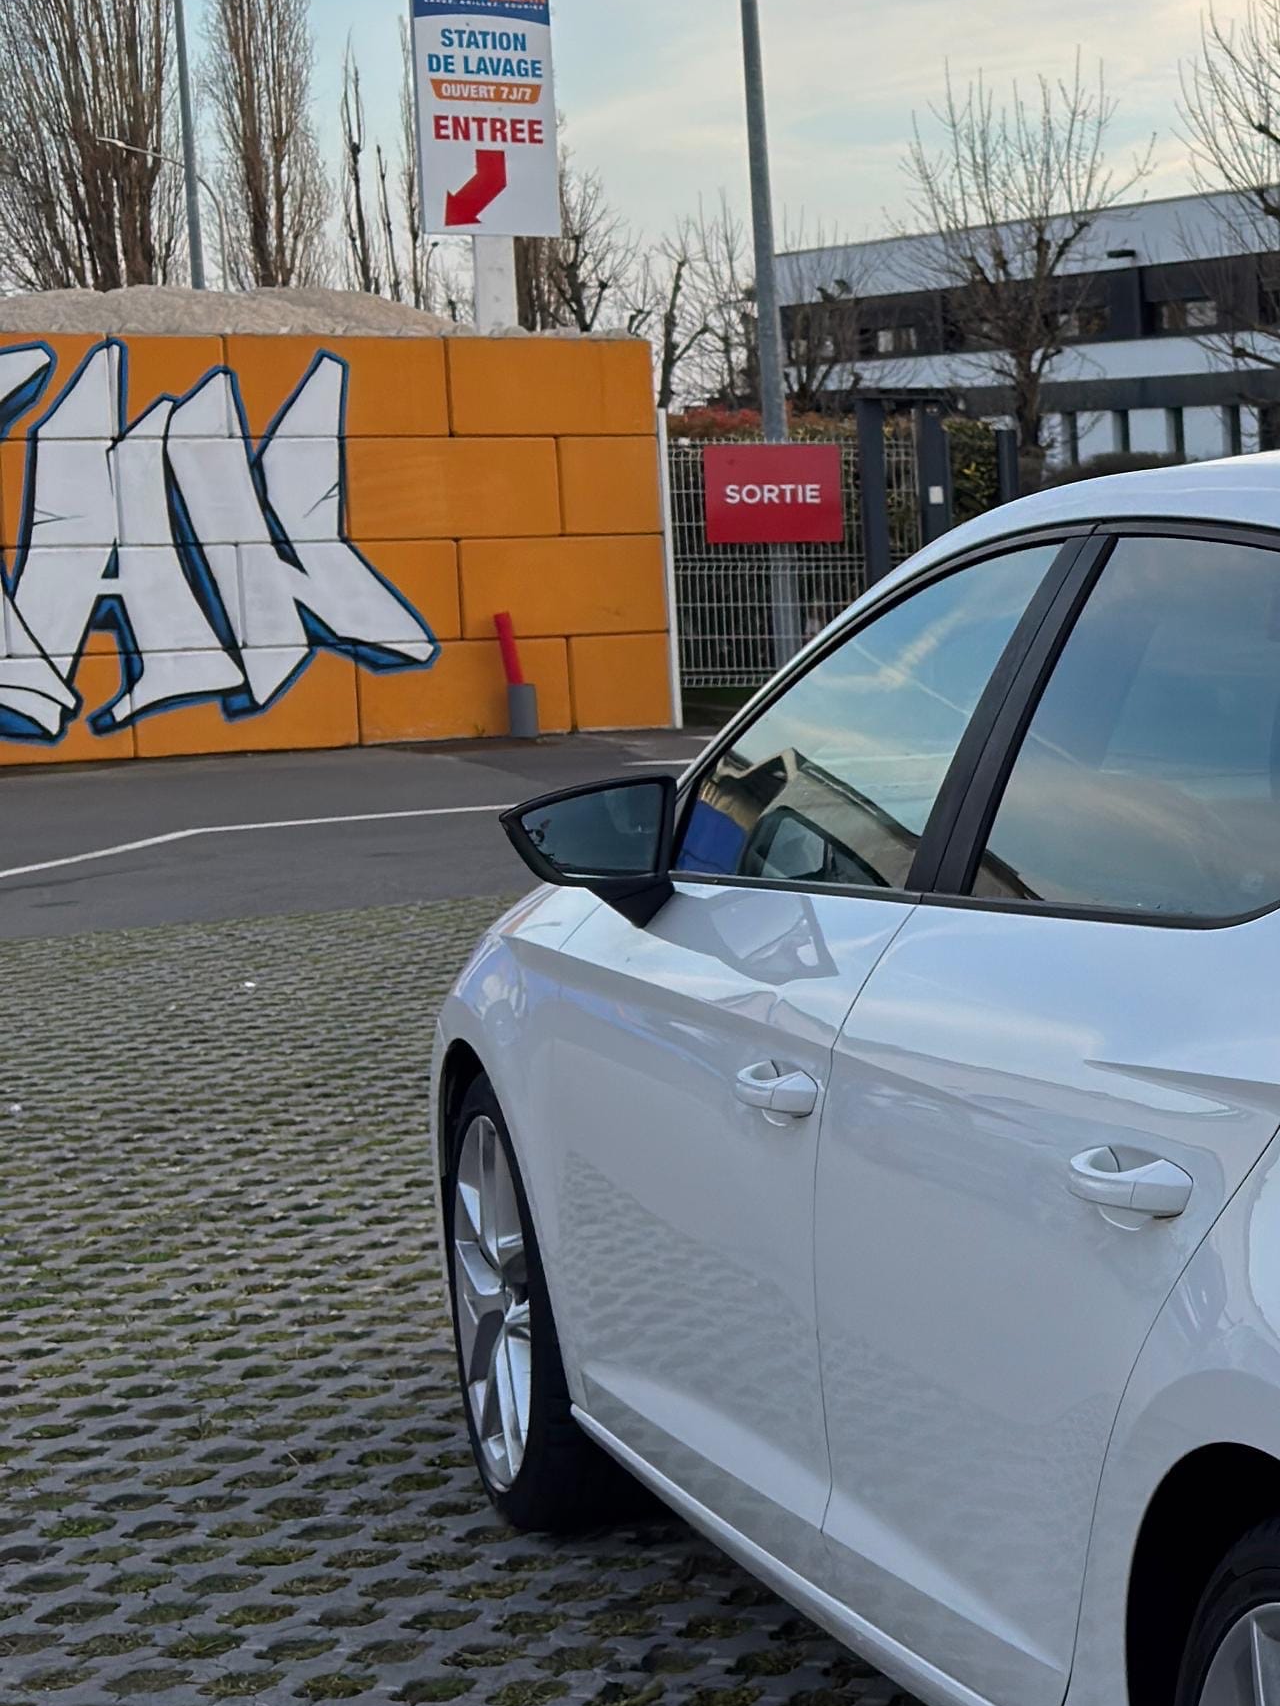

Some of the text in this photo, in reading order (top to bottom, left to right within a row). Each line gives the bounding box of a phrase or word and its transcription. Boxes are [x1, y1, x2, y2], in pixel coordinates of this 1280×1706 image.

[440, 28, 526, 51] STATION
[427, 54, 543, 78] DE LAVAGE
[441, 83, 532, 101] OUVERT 7J/7
[433, 115, 544, 144] ENTREE
[725, 483, 821, 505] SORTIE
